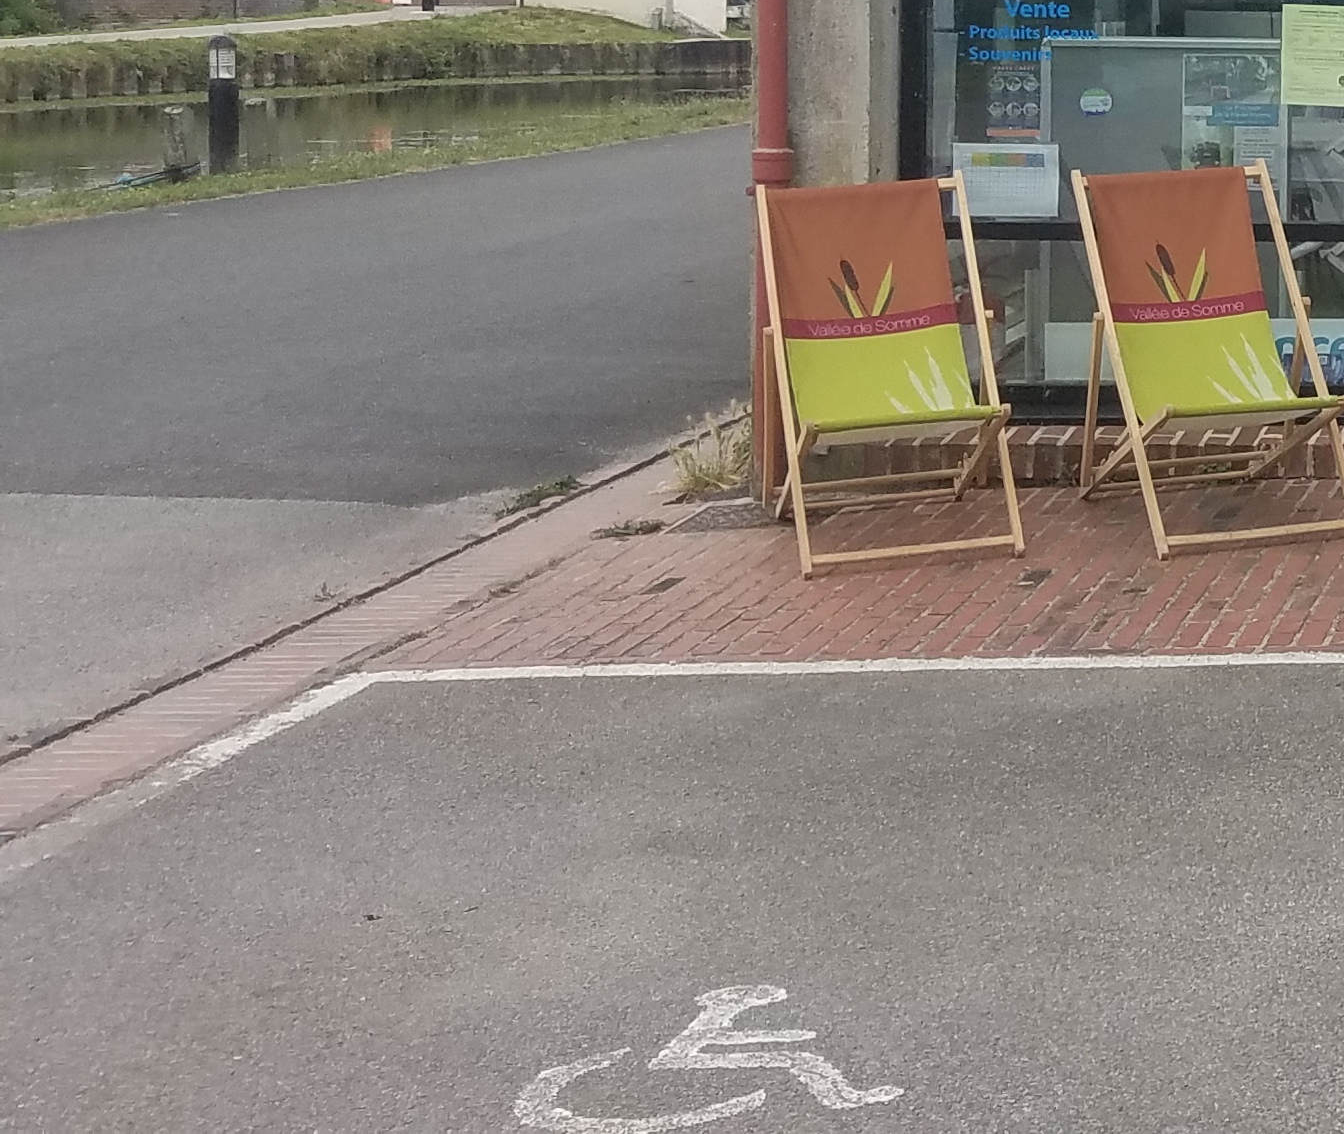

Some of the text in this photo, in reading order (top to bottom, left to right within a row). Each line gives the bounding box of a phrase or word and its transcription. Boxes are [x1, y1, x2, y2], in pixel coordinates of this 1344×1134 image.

[1004, 0, 1071, 19] Vente
[969, 24, 1098, 40] Produits locaux
[968, 46, 1052, 61] Souvenirs
[1130, 301, 1245, 320] Vallée de Somme
[808, 315, 931, 336] Vallée de Somme
